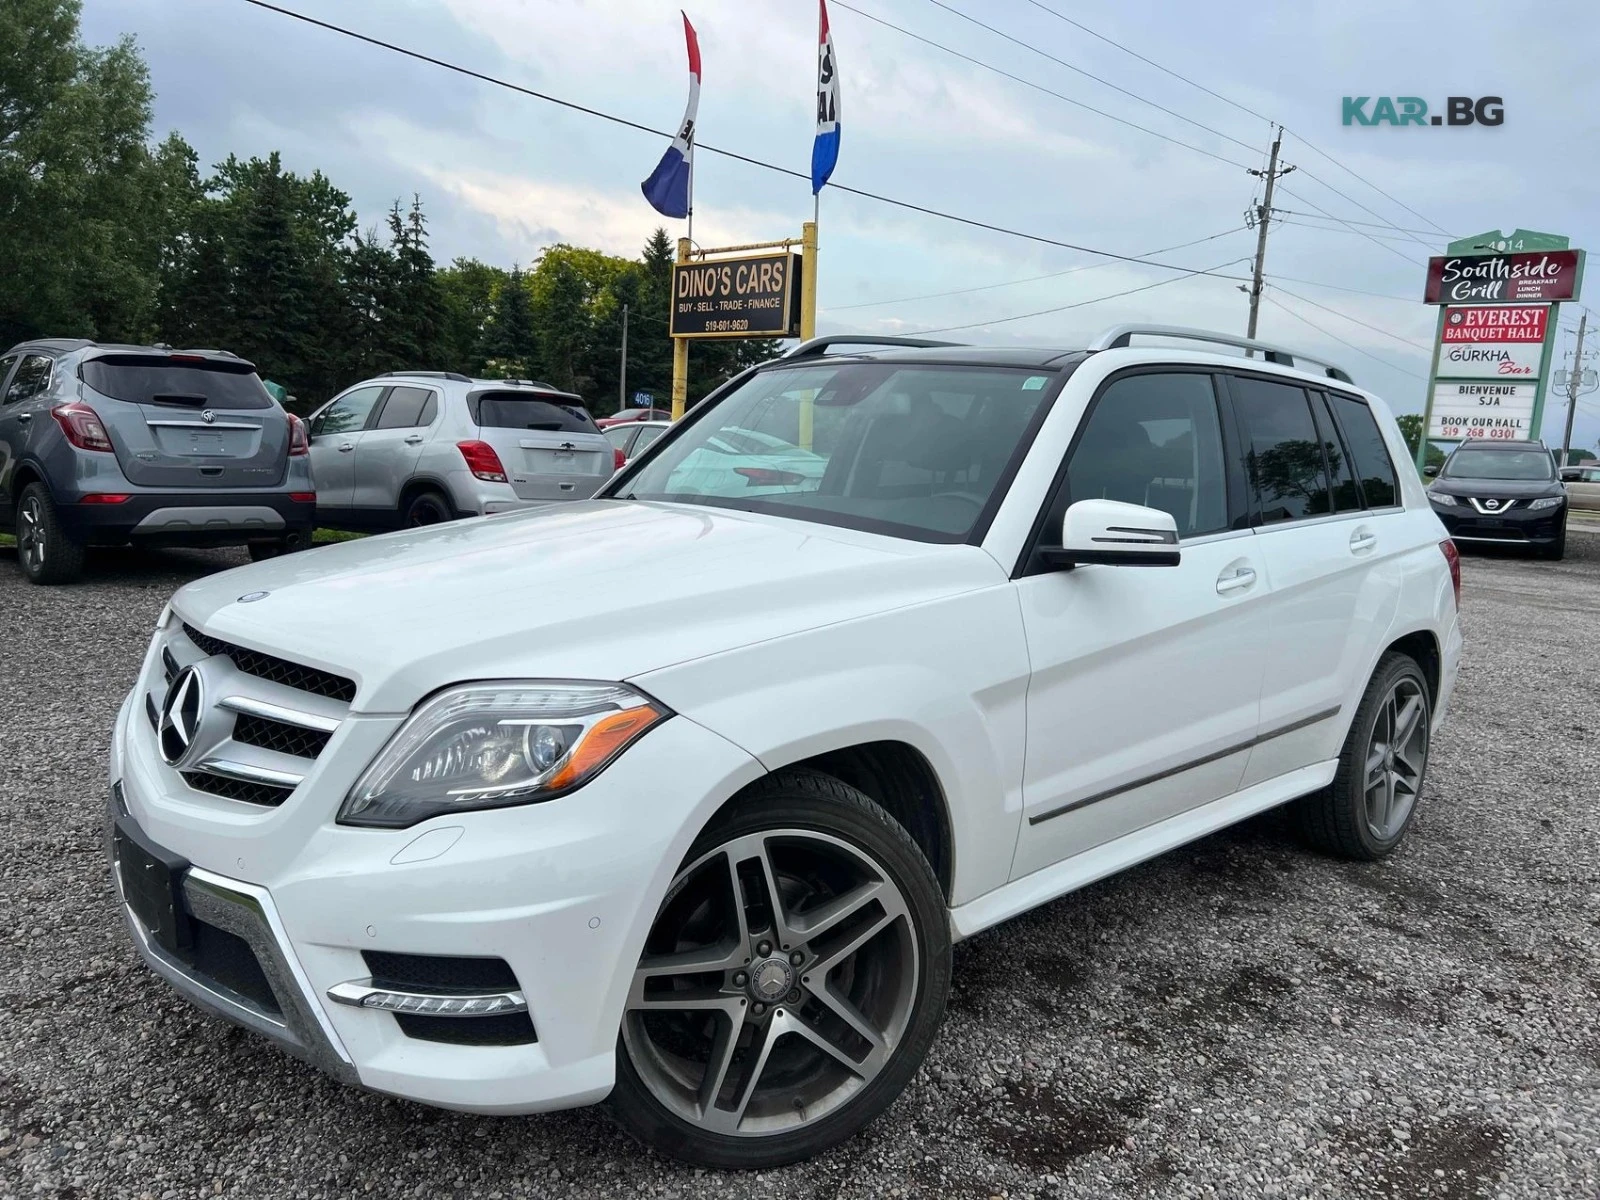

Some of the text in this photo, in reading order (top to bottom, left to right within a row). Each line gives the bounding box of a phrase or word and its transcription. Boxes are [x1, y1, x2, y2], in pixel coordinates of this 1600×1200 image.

[1442, 257, 1562, 282] Southside
[678, 262, 783, 298] DINO'S CARS
[1451, 281, 1503, 300] Grill
[679, 303, 693, 313] BUY
[697, 302, 714, 312] SELL
[720, 300, 743, 310] TRADE
[748, 297, 780, 309] FINANCE
[1465, 309, 1544, 326] EVEREST
[705, 319, 749, 331] 519-601-9620
[1446, 327, 1542, 341] BANQUET HALL
[1450, 350, 1511, 361] GURKHA
[1498, 361, 1534, 375] Bar
[1459, 385, 1517, 396] BIENVENUE
[634, 392, 650, 405] 4016
[1479, 396, 1501, 406] SJA
[1441, 416, 1522, 428] BOOK OUR HALL
[1442, 426, 1515, 439] 519 268 0301
